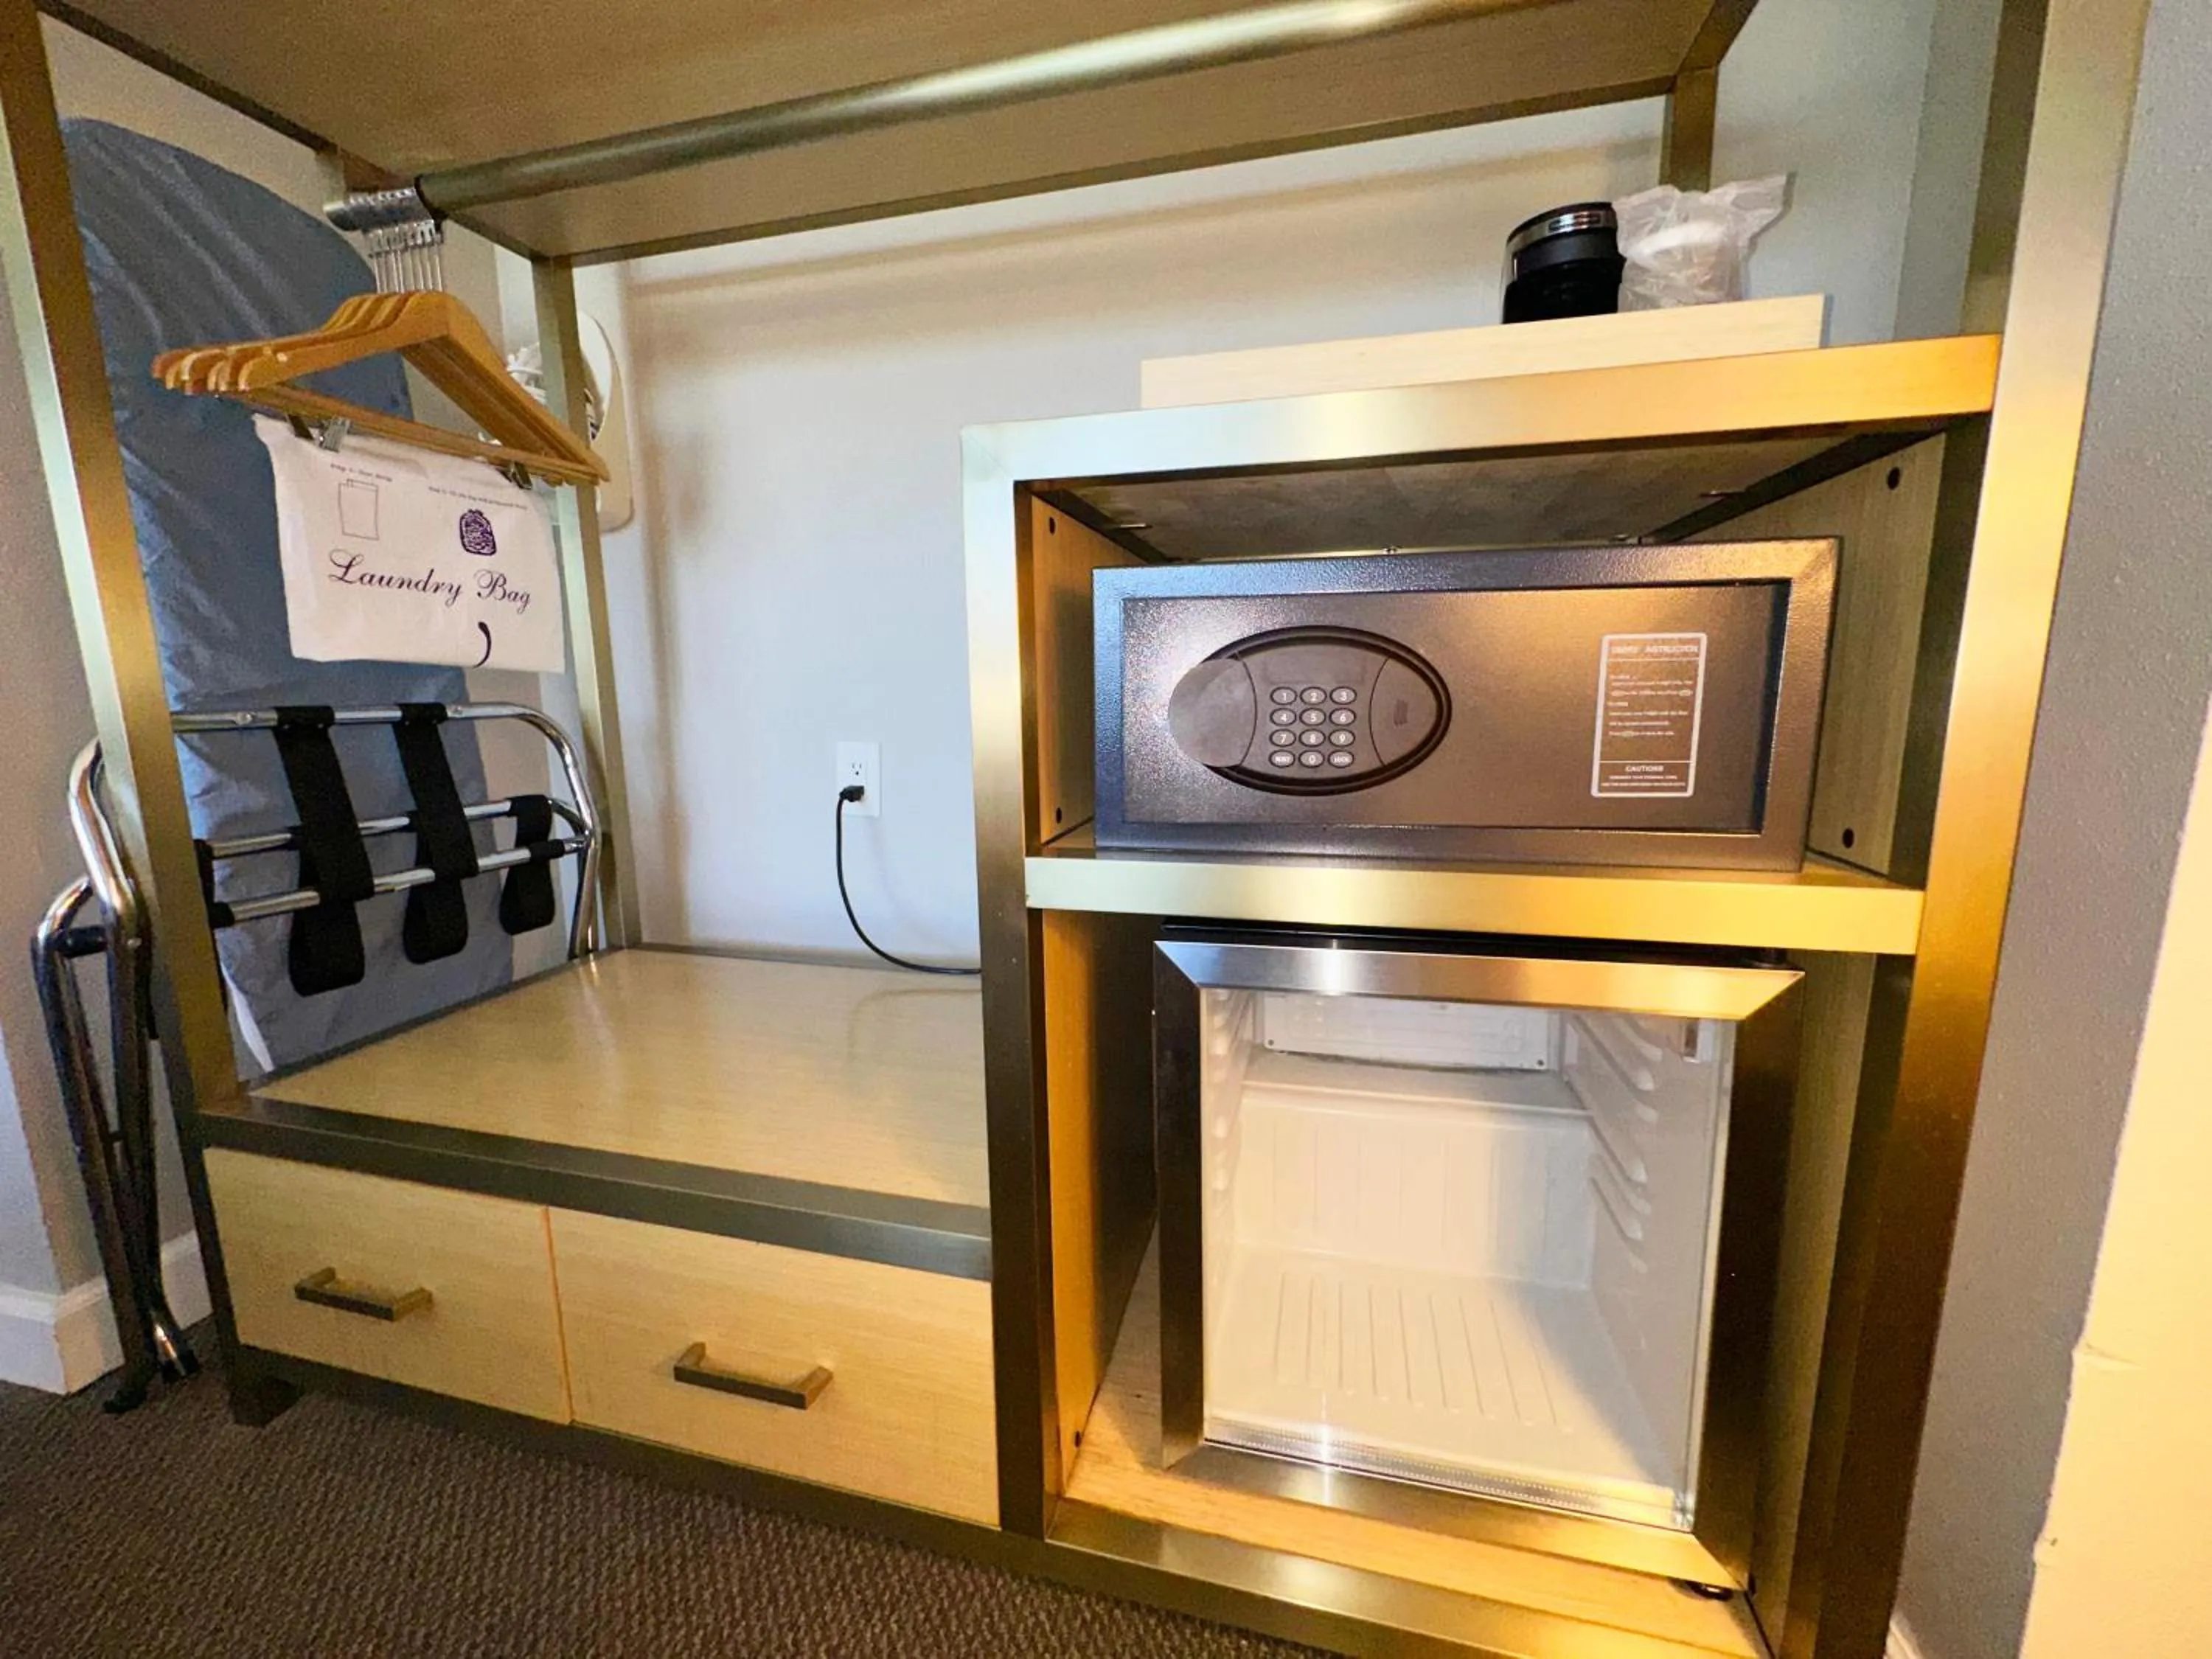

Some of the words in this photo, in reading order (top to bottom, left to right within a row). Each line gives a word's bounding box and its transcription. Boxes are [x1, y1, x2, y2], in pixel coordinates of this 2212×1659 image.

[328, 549, 462, 608] Laundry
[474, 568, 531, 614] Bag
[1281, 692, 1287, 702] 1
[1310, 691, 1318, 702] 2
[1340, 691, 1348, 701] 3
[1280, 712, 1288, 723] 4
[1310, 712, 1318, 723] 5
[1339, 712, 1347, 723] 6
[1279, 733, 1287, 744] 7
[1309, 733, 1317, 744] 8
[1338, 733, 1346, 744] 9
[1308, 754, 1317, 765] 0
